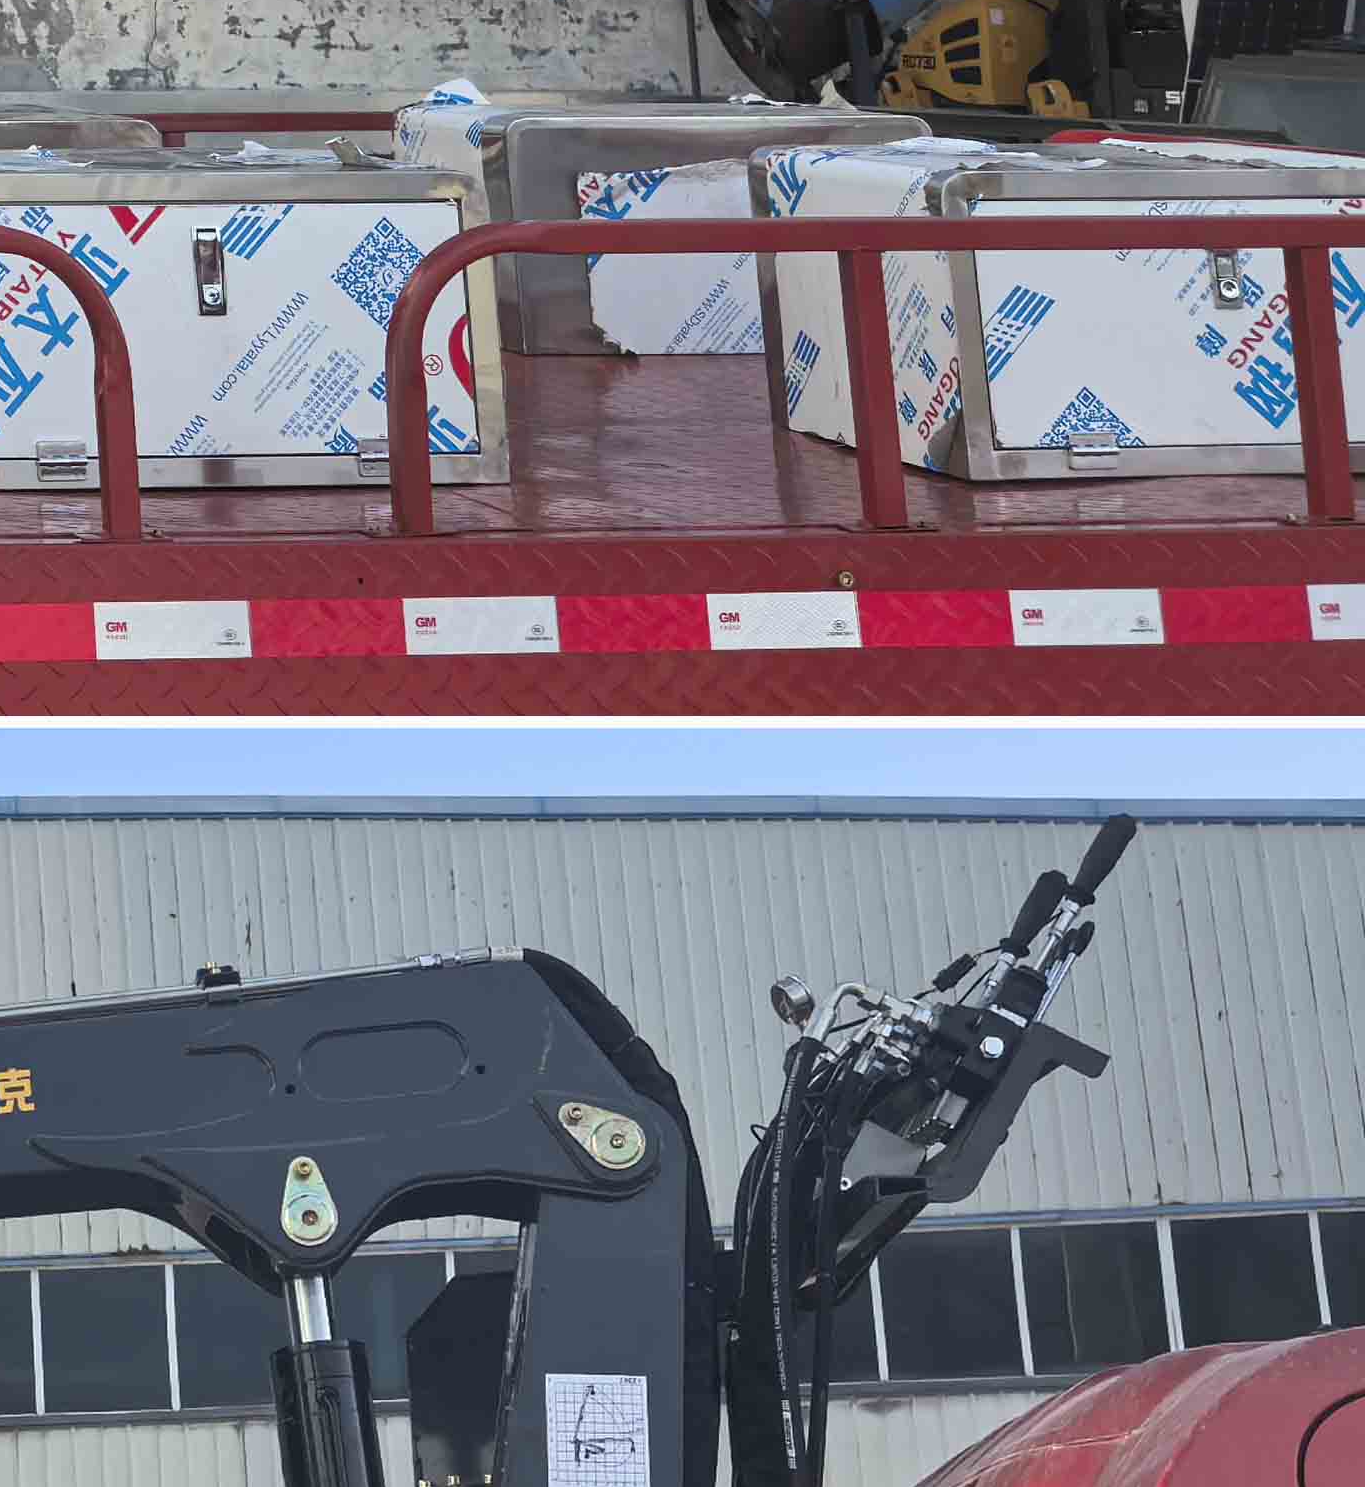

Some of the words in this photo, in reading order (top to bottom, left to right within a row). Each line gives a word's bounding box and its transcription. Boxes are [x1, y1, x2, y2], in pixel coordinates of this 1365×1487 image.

[1022, 608, 1043, 619] GM
[1320, 603, 1340, 614] GM
[416, 617, 437, 628] GM
[719, 612, 740, 623] GM
[106, 622, 127, 633] GM
